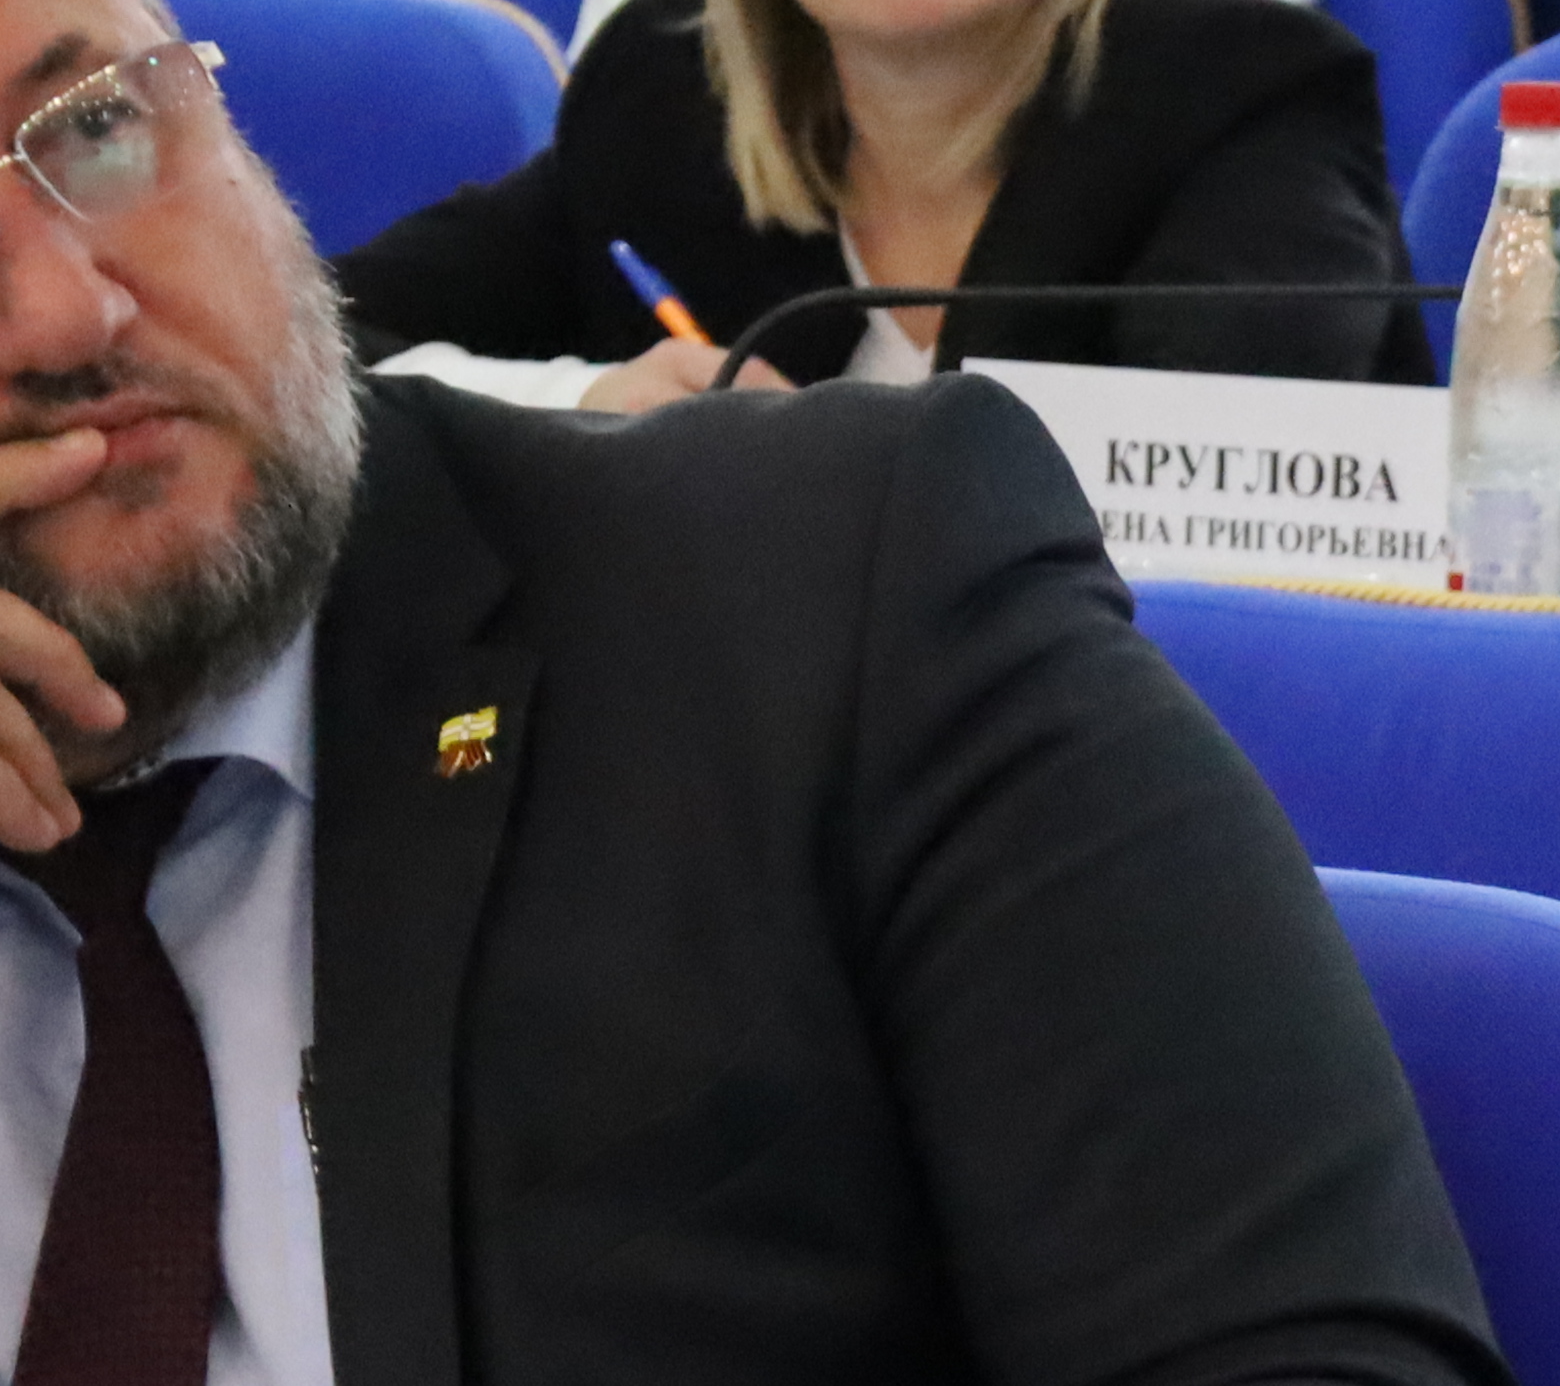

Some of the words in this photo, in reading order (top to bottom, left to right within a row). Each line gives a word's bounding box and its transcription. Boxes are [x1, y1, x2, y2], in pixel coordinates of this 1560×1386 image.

[1106, 438, 1398, 503] КРУГЛОВА
[1101, 509, 1171, 546] ЕНА
[1184, 515, 1457, 563] ГРИГОРЬЕВНА
